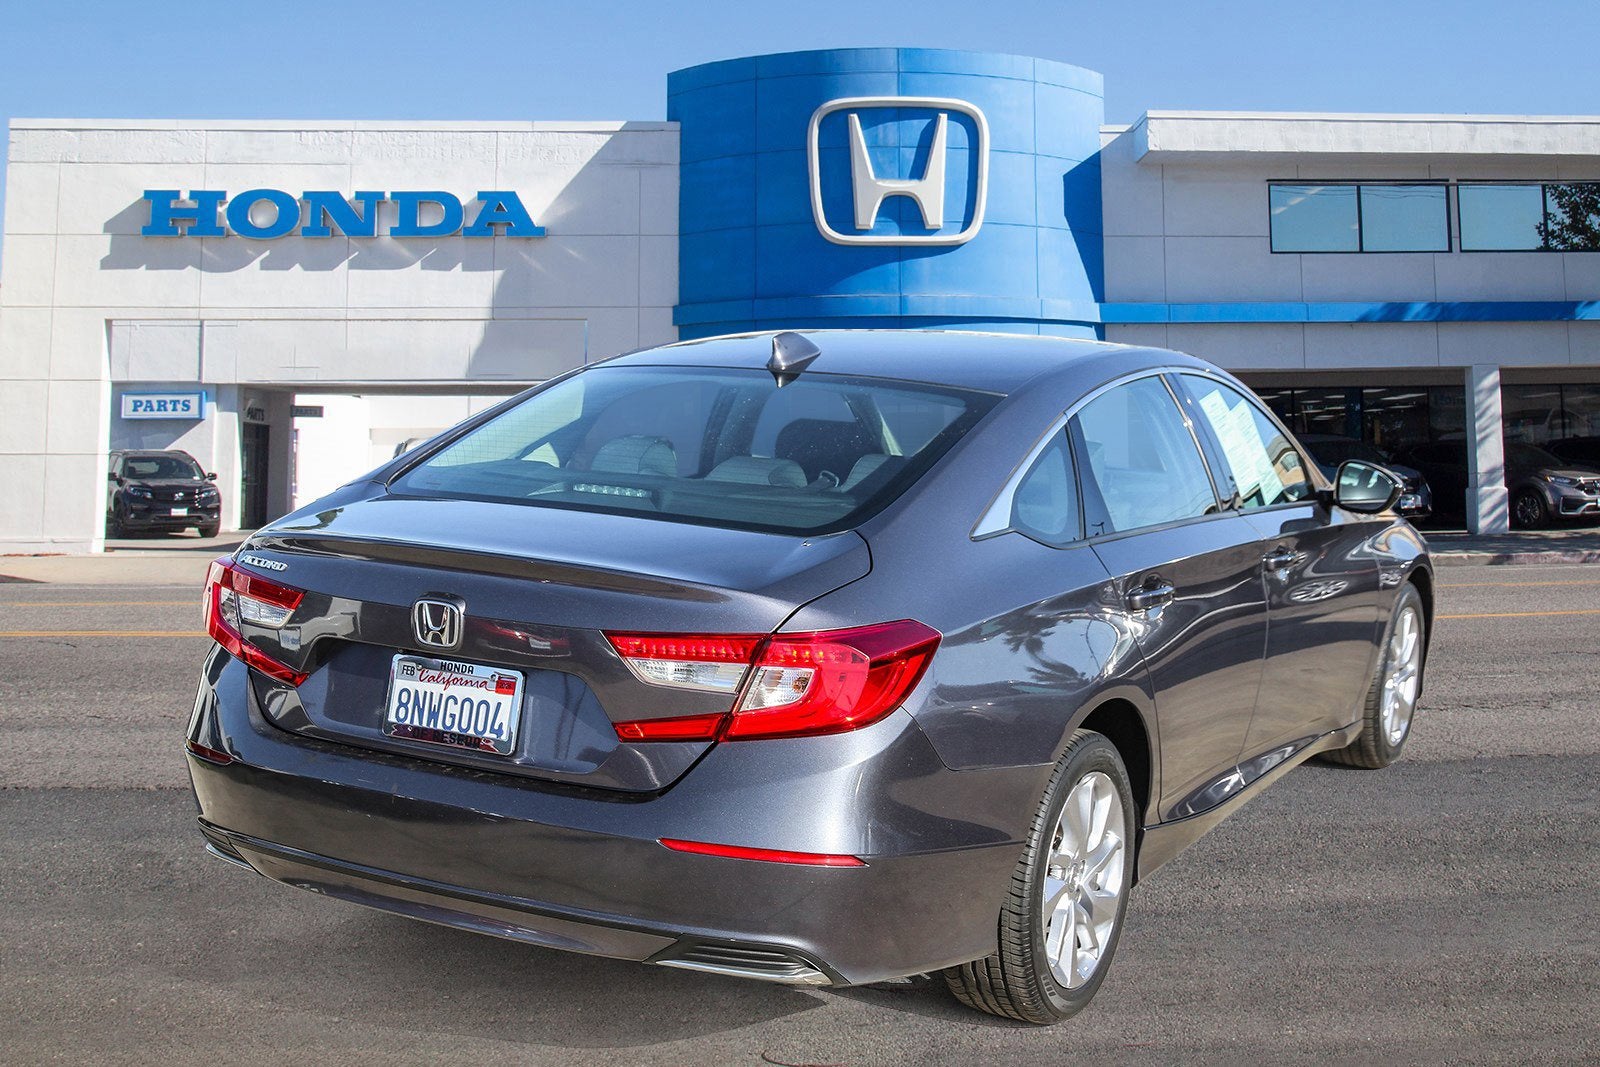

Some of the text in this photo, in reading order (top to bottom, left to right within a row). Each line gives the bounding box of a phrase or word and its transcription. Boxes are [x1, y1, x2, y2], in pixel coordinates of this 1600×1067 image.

[141, 189, 547, 239] HONDA
[132, 399, 191, 412] PARTS
[240, 554, 288, 571] ACCORD
[401, 664, 416, 677] FEB
[440, 661, 474, 675] HONDA
[418, 667, 494, 691] California
[395, 687, 504, 739] 8NWG004
